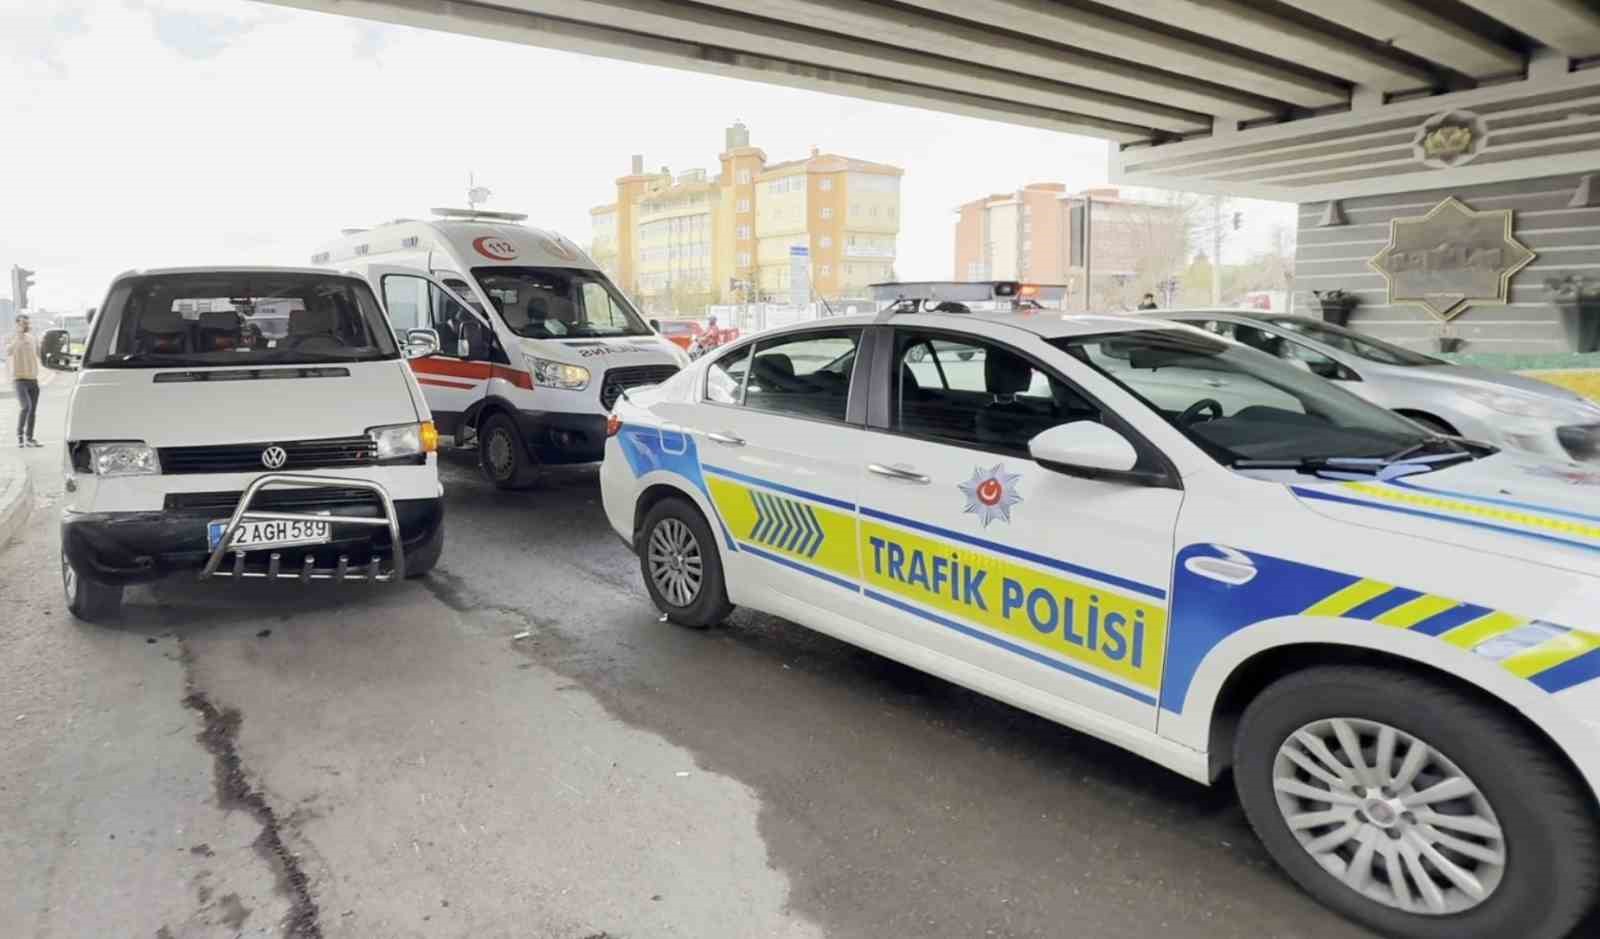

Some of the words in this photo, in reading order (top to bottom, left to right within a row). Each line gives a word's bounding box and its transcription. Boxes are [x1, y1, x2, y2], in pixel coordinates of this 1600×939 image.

[488, 242, 515, 254] 112
[252, 521, 287, 542] AGH
[291, 520, 326, 538] 589
[869, 536, 989, 612] TRAFİK
[1002, 577, 1145, 669] POLİSİ
